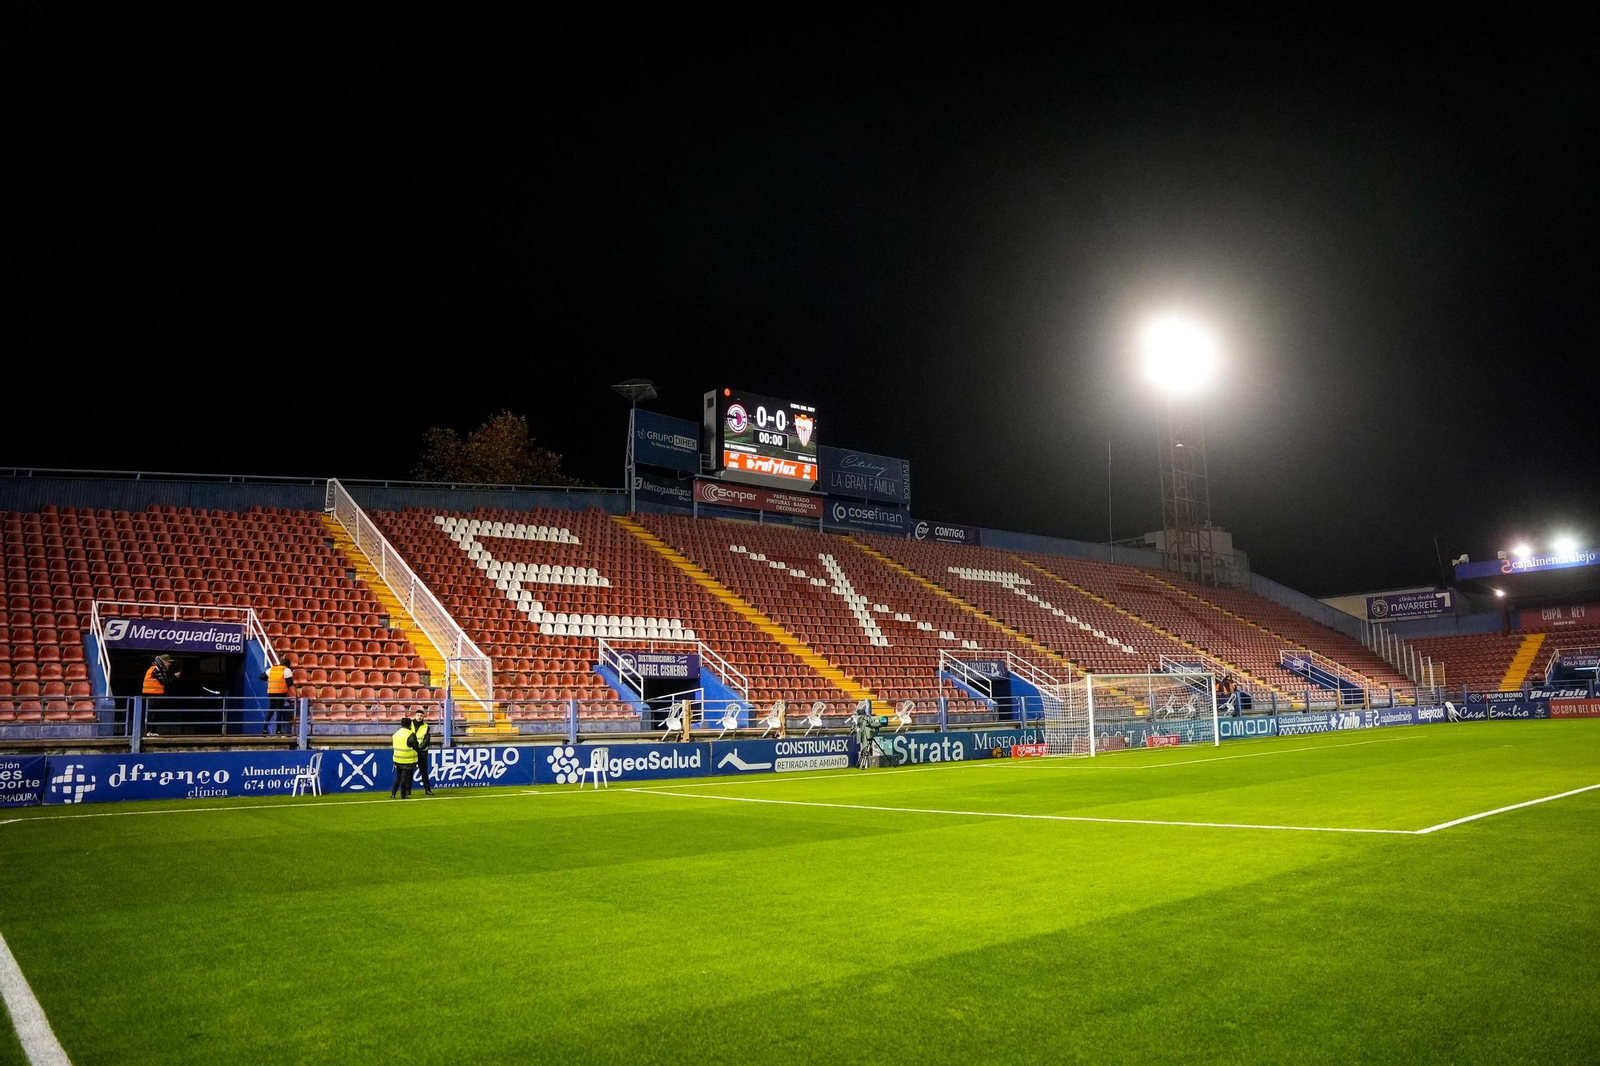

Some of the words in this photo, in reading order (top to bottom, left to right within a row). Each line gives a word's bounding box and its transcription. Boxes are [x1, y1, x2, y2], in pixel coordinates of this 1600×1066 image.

[647, 431, 674, 443] GRUPO
[675, 435, 696, 448] DIHEX
[759, 432, 783, 447] 00:00
[840, 454, 888, 477] Catering
[643, 481, 692, 497] Mercoguadiana
[831, 472, 841, 487] LA
[844, 474, 867, 490] GRAN
[868, 478, 896, 495] FAMILIA
[718, 488, 757, 502] Sanper
[766, 498, 790, 506] PINTURAS
[776, 505, 807, 514] DECORACIÓN
[848, 507, 903, 523] cosefinan
[1512, 551, 1595, 571] cajalmendralejo
[1541, 608, 1562, 620] COPA
[1571, 606, 1585, 619] REY
[129, 624, 241, 645] Mercoguadiana
[216, 643, 242, 652] Grupo
[638, 654, 676, 663] DISTRIBUCIONES
[638, 664, 660, 676] RAFAEL
[660, 664, 688, 677] CISNEROS
[1417, 706, 1444, 723] telepizza
[1459, 706, 1486, 719] Casa
[1489, 704, 1529, 719] Emilio
[1560, 704, 1577, 714] COPA
[1577, 704, 1589, 714] DEL
[1019, 731, 1037, 746] del
[775, 739, 849, 755] CONSTRUMAEX
[893, 735, 964, 765] Strata
[428, 747, 519, 768] TEMPLO
[777, 760, 808, 769] RETIRADA
[810, 760, 817, 768] DE
[819, 758, 848, 767] AMIANTO
[108, 764, 230, 788] dfranco
[244, 780, 265, 790] 674
[267, 779, 281, 789] 00
[284, 779, 296, 789] 69
[187, 787, 228, 798] clínica
